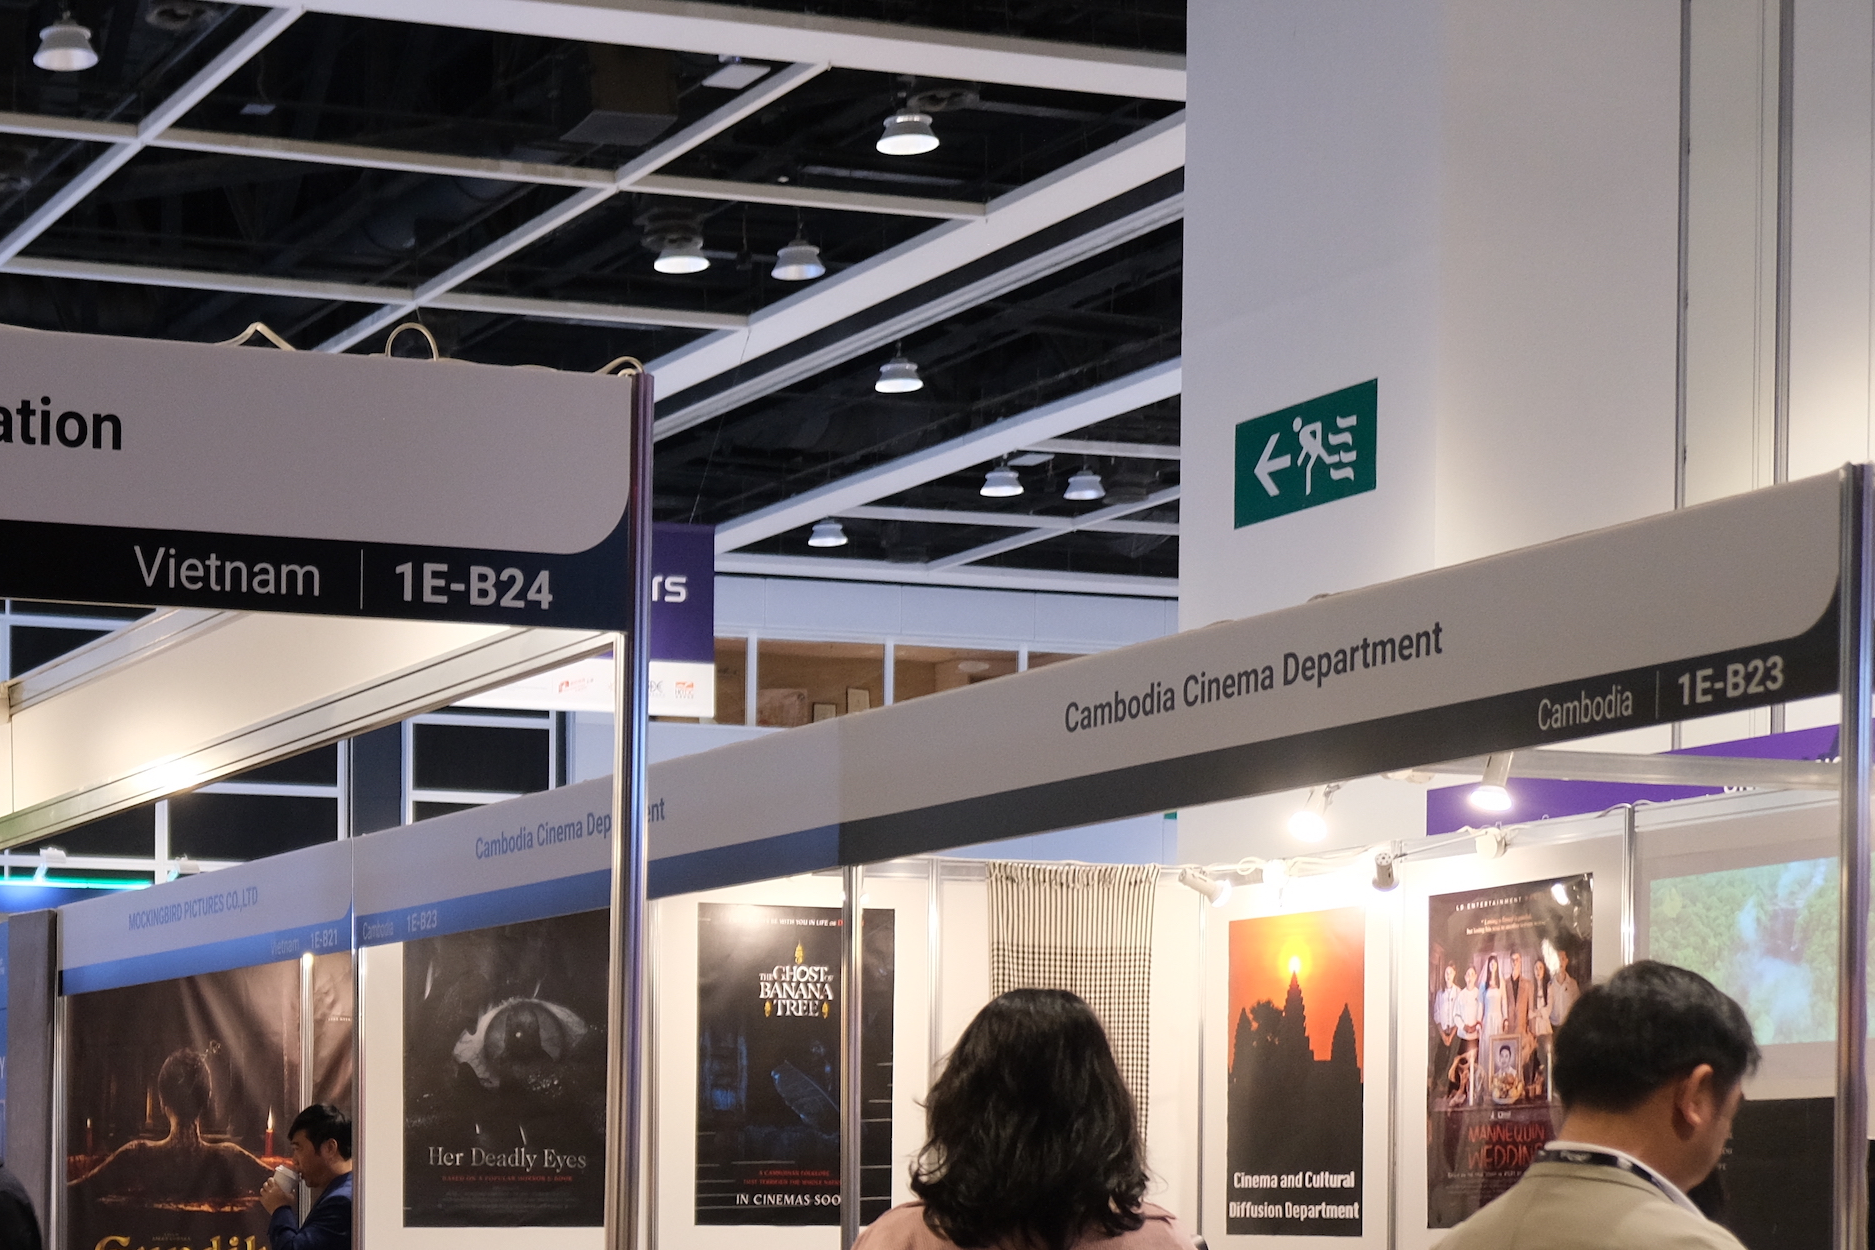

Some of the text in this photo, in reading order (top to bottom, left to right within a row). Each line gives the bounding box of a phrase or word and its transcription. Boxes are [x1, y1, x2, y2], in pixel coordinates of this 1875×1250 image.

[134, 545, 553, 609] Vietnam 1E-B24
[1065, 621, 1443, 733] Cambodia Cinema Department
[1537, 655, 1785, 731] Cambodia 1E-B23
[475, 827, 534, 860] Cambodia
[536, 820, 583, 847] Cinema
[128, 902, 183, 931] MOCKINGBIRD
[183, 893, 225, 917] PICTURES
[362, 910, 438, 941] Cambodia 1E-B23
[816, 919, 829, 927] LIFE
[310, 929, 338, 950] 1E-B21
[773, 964, 828, 983] GHOST
[759, 982, 834, 1000] BANANA
[773, 999, 820, 1017] TREE
[1467, 1123, 1545, 1144] MANNEQUIN
[428, 1146, 587, 1173] Her Deadly Eyes
[1233, 1171, 1355, 1188] Cinema and Cultural
[736, 1194, 841, 1206] IN CINEMAS SOO
[1228, 1202, 1360, 1221] Diffusion Department
